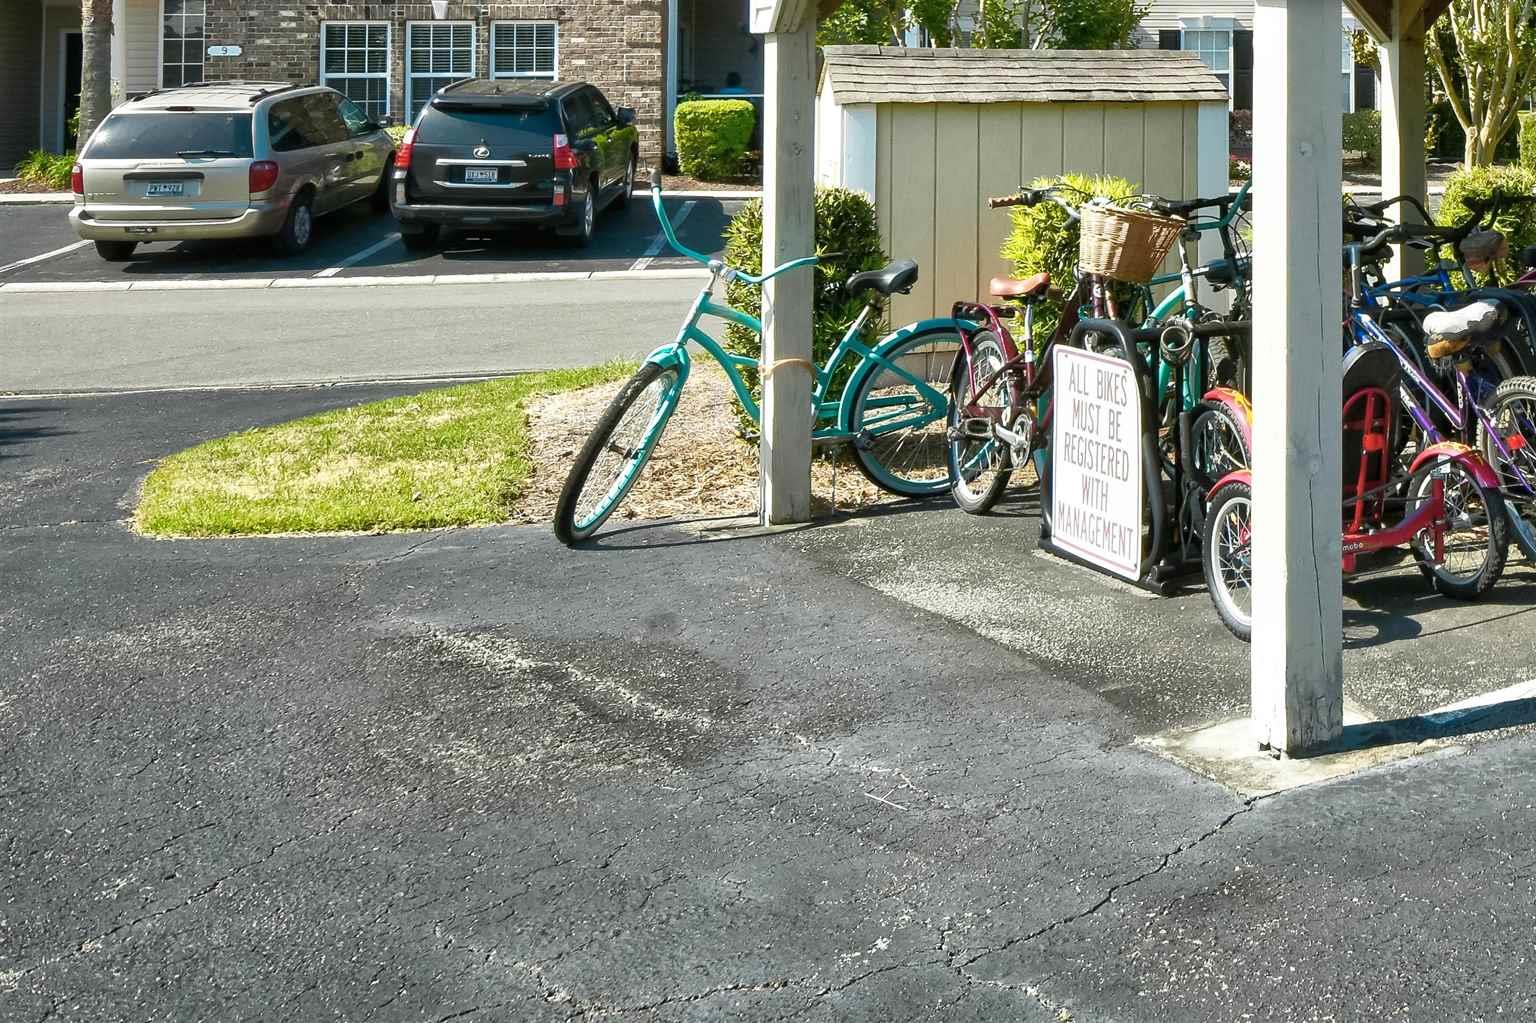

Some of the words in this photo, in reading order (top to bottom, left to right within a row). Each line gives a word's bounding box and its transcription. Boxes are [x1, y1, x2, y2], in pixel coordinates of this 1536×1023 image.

[1068, 361, 1089, 396] ALL
[1096, 368, 1128, 408] BIKES
[1072, 398, 1101, 435] MUST
[1108, 409, 1123, 443] BE
[1063, 431, 1130, 483] REGISTERED
[1081, 474, 1109, 514] WITH
[1057, 499, 1134, 562] MANAGEMENT
